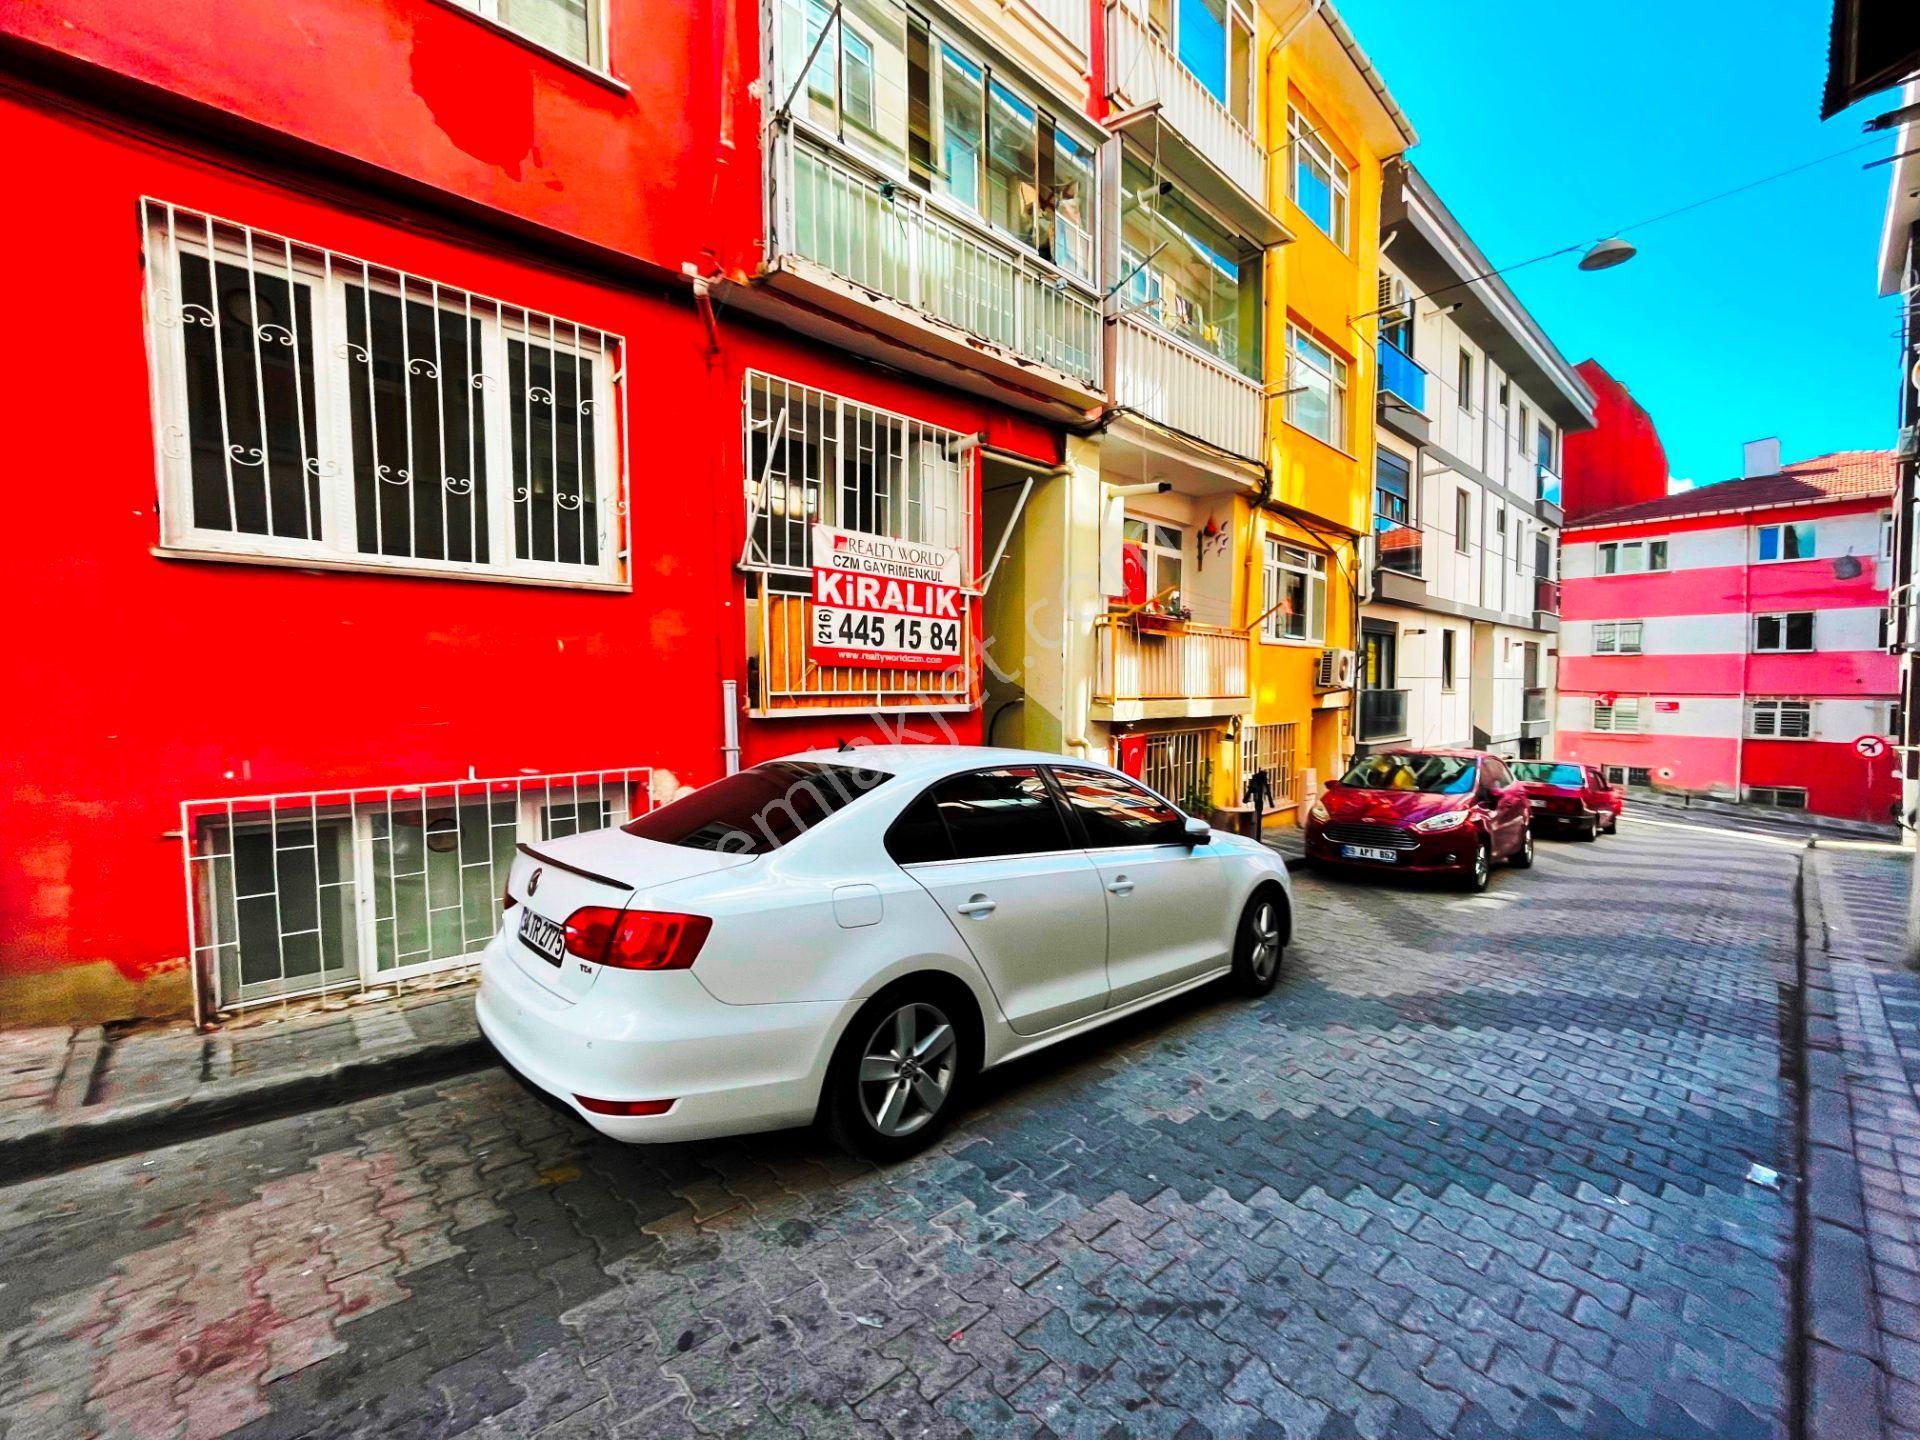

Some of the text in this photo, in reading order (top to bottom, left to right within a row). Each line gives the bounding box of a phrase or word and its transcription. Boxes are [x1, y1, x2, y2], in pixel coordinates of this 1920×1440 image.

[833, 554, 860, 571] CZM
[848, 537, 945, 567] REALTY WORLD
[818, 608, 957, 652] (216) 445 15 84
[529, 914, 543, 943] TR
[538, 921, 562, 955] 2775
